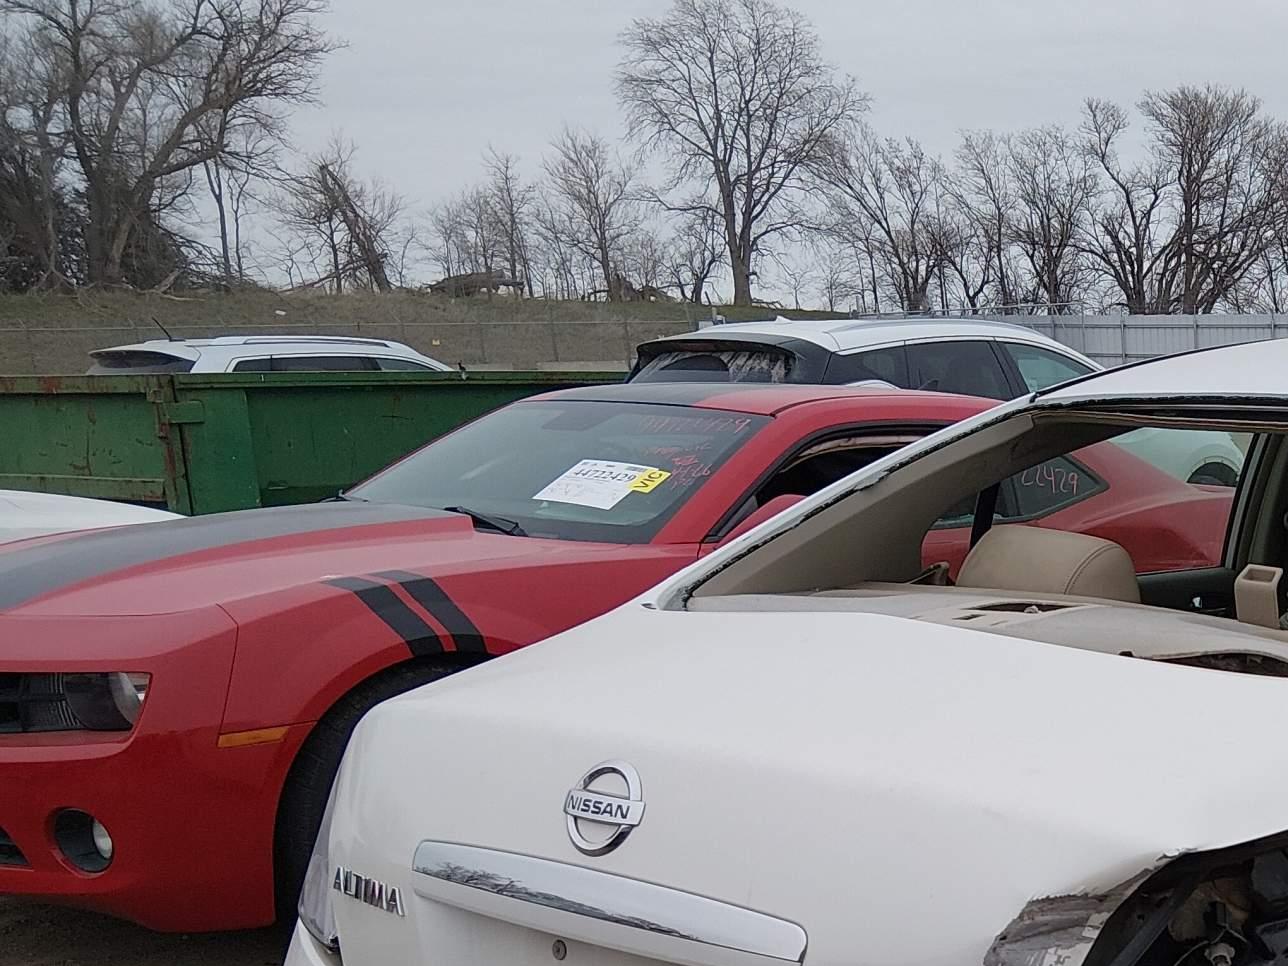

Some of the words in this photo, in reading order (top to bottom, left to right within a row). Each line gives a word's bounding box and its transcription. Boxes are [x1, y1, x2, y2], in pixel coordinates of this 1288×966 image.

[574, 468, 637, 483] 44722429
[633, 471, 663, 490] VIC
[567, 794, 631, 820] NISSAN
[333, 866, 405, 918] ALTIMA
